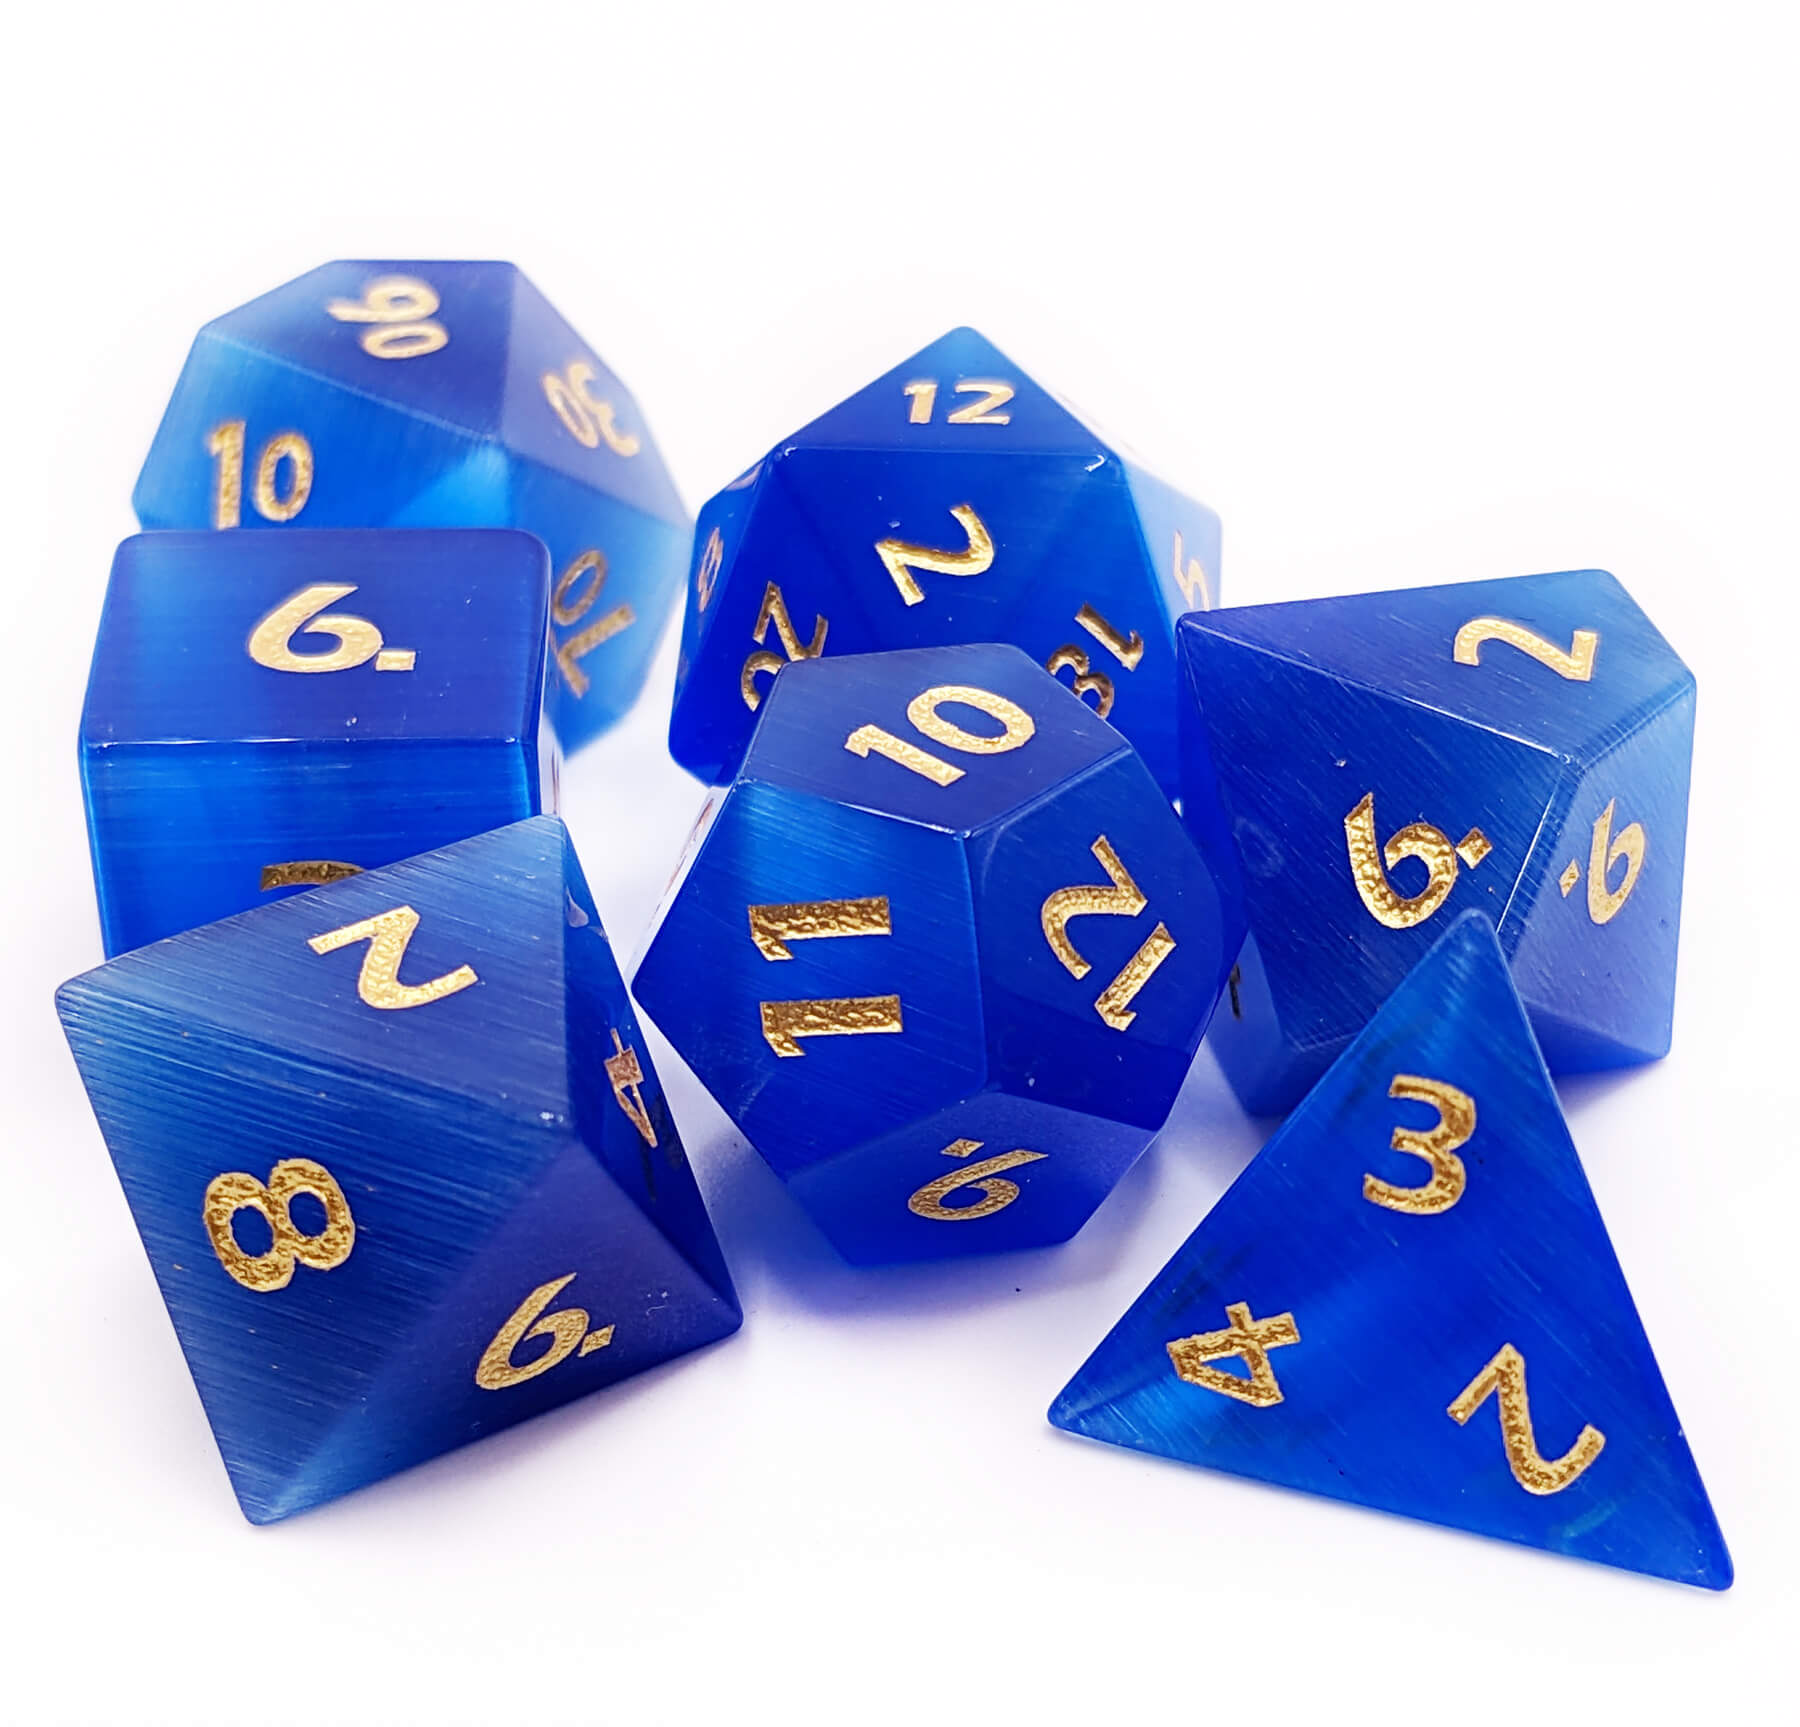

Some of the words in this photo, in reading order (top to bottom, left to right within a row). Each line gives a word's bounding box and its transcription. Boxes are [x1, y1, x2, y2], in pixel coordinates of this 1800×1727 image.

[905, 382, 1014, 424] 12
[208, 418, 313, 528] 10
[877, 503, 994, 606] 2
[1453, 616, 1598, 682] 2
[845, 685, 1036, 786] 10
[308, 906, 478, 1010] 2
[747, 895, 904, 1058] 11
[1041, 835, 1180, 1030] 12
[1362, 1073, 1477, 1215] 3
[202, 1156, 356, 1293] 8
[1166, 1301, 1301, 1408] 4
[1447, 1342, 1606, 1496] 2
